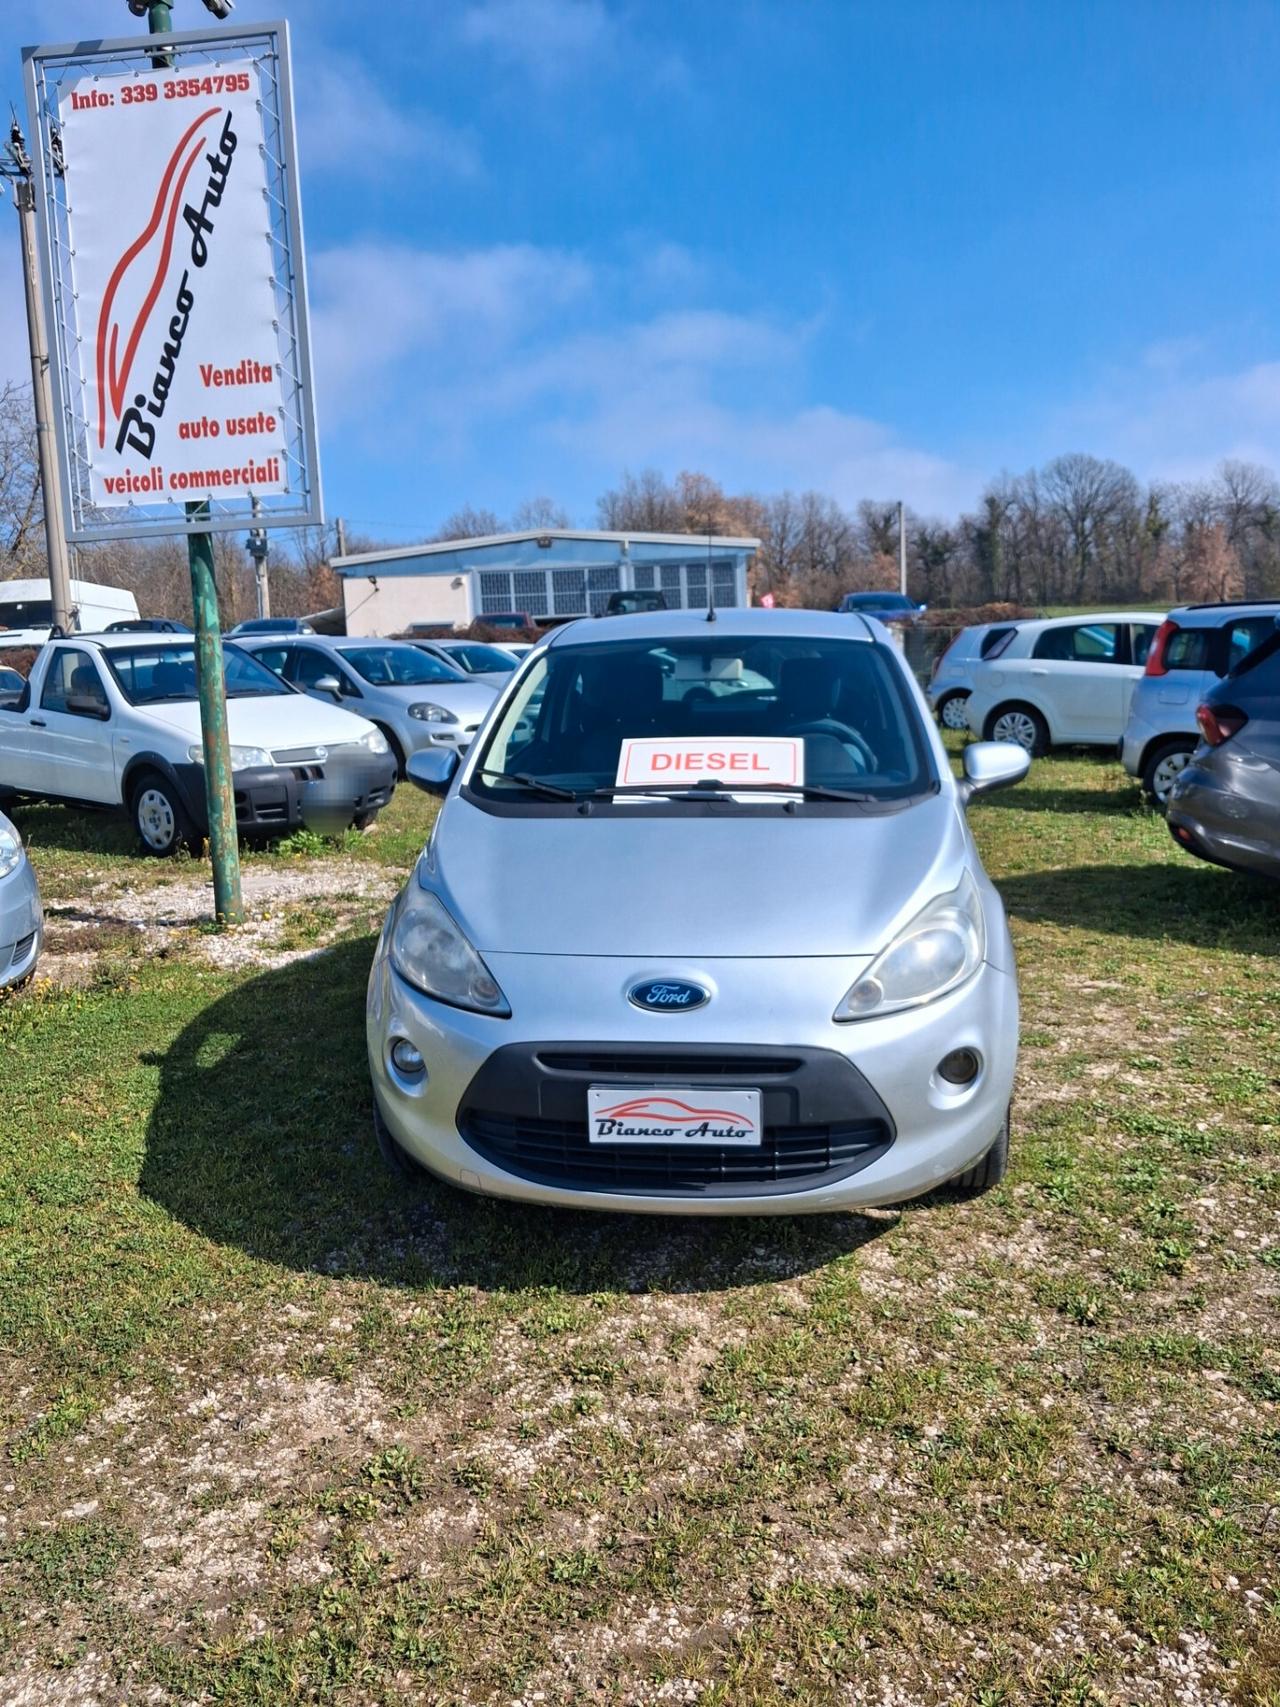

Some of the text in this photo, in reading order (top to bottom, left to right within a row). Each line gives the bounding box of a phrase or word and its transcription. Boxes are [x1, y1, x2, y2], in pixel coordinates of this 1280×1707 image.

[71, 73, 250, 110] Info: 339 3354795
[115, 110, 238, 460] Bianco Auto
[200, 359, 273, 388] Vendita
[179, 412, 276, 440] auto usate
[104, 457, 279, 494] veicoli commerciali
[650, 752, 770, 771] DIESEL
[646, 984, 691, 1004] Ford
[595, 1118, 753, 1139] Bianco Auto
